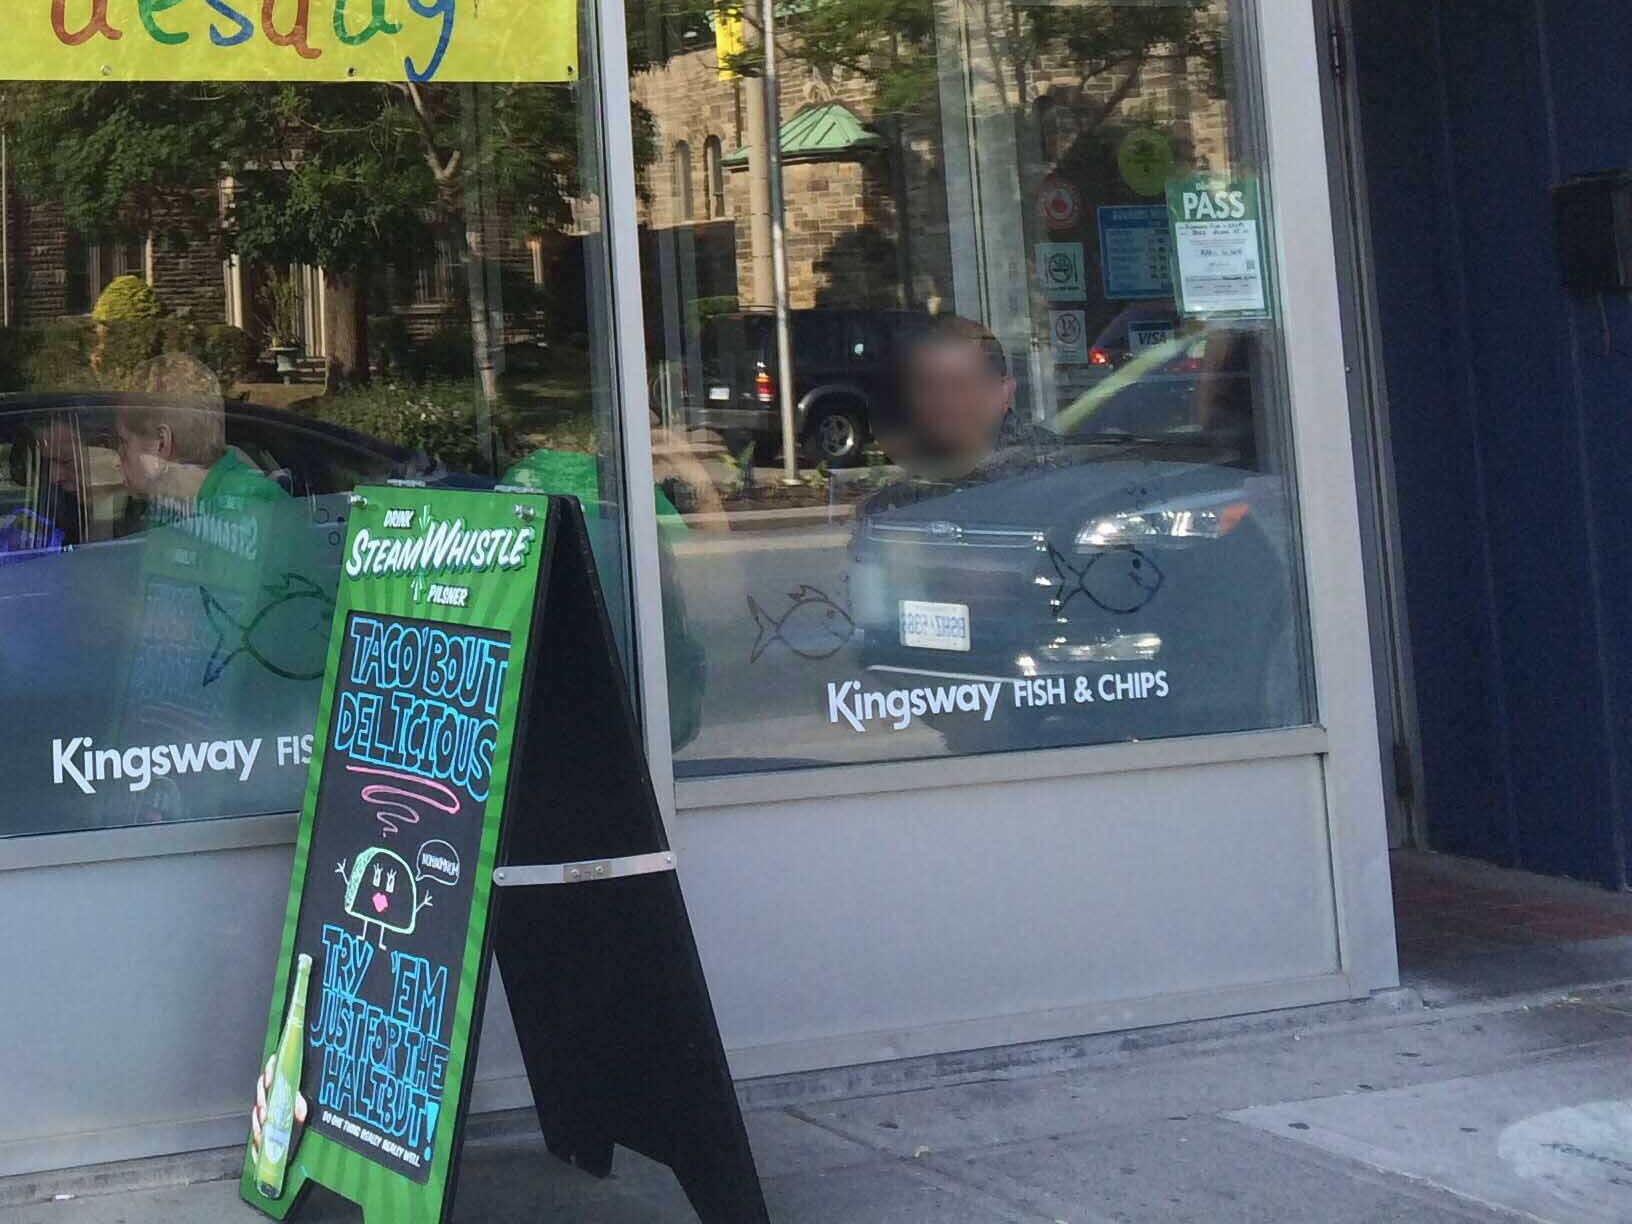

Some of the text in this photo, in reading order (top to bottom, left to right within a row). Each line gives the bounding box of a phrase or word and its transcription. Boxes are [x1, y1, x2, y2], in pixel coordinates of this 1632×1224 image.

[1182, 190, 1245, 219] PASS
[383, 509, 414, 528] DRINK
[427, 584, 468, 607] PILSNER
[828, 671, 1169, 732] Kingsway FISH & CHIPS
[52, 736, 262, 794] Kingsway
[334, 691, 499, 802] DELICIOUS
[322, 924, 374, 998] TRY
